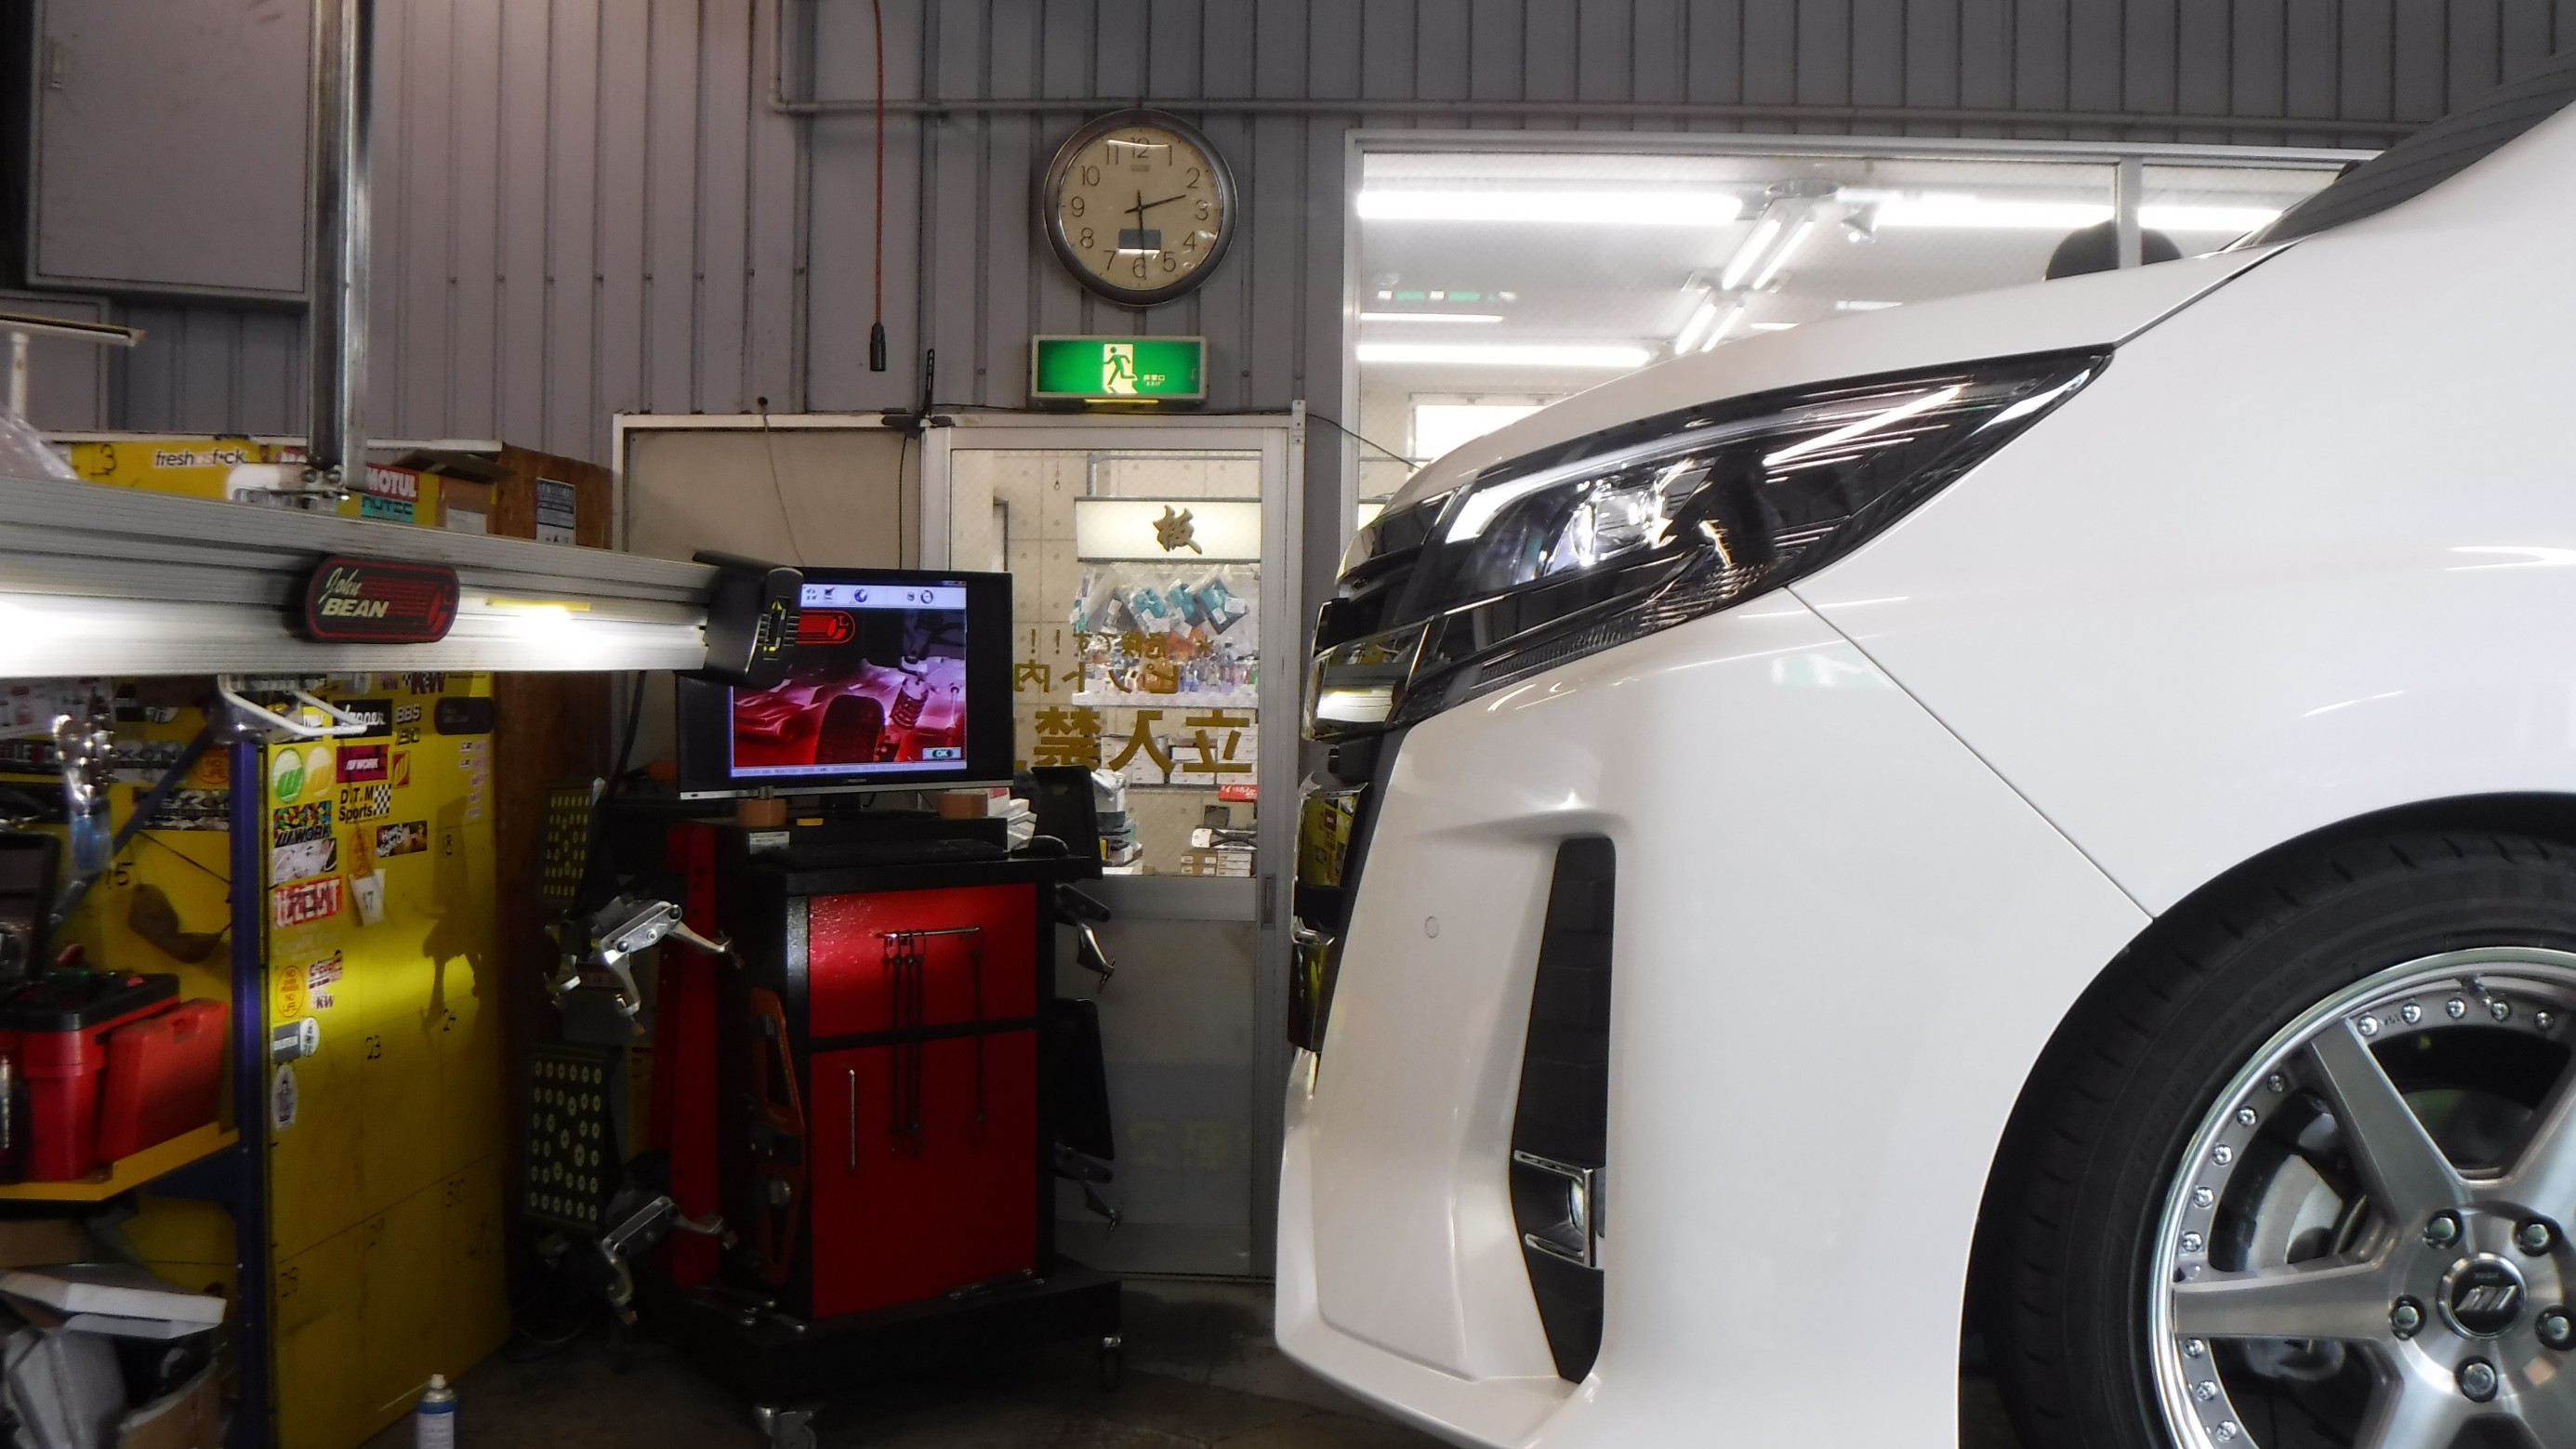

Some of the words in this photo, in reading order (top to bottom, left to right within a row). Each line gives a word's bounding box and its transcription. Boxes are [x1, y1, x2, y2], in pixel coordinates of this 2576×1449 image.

[1105, 144, 1119, 165] 11
[1130, 138, 1150, 159] 12
[1167, 145, 1173, 165] 1
[1081, 165, 1101, 187] 10
[1186, 167, 1201, 190] 2
[1071, 196, 1085, 217] 9
[1195, 200, 1209, 221] 3
[1080, 228, 1094, 249] 8
[1182, 231, 1197, 251] 4
[1104, 250, 1116, 270] 7
[1132, 257, 1146, 279] 6
[1163, 251, 1176, 272] 5
[319, 566, 363, 603] John
[321, 598, 390, 618] BEAN
[396, 704, 421, 724] BBS
[338, 803, 373, 824] Sports
[316, 995, 335, 1009] KW
